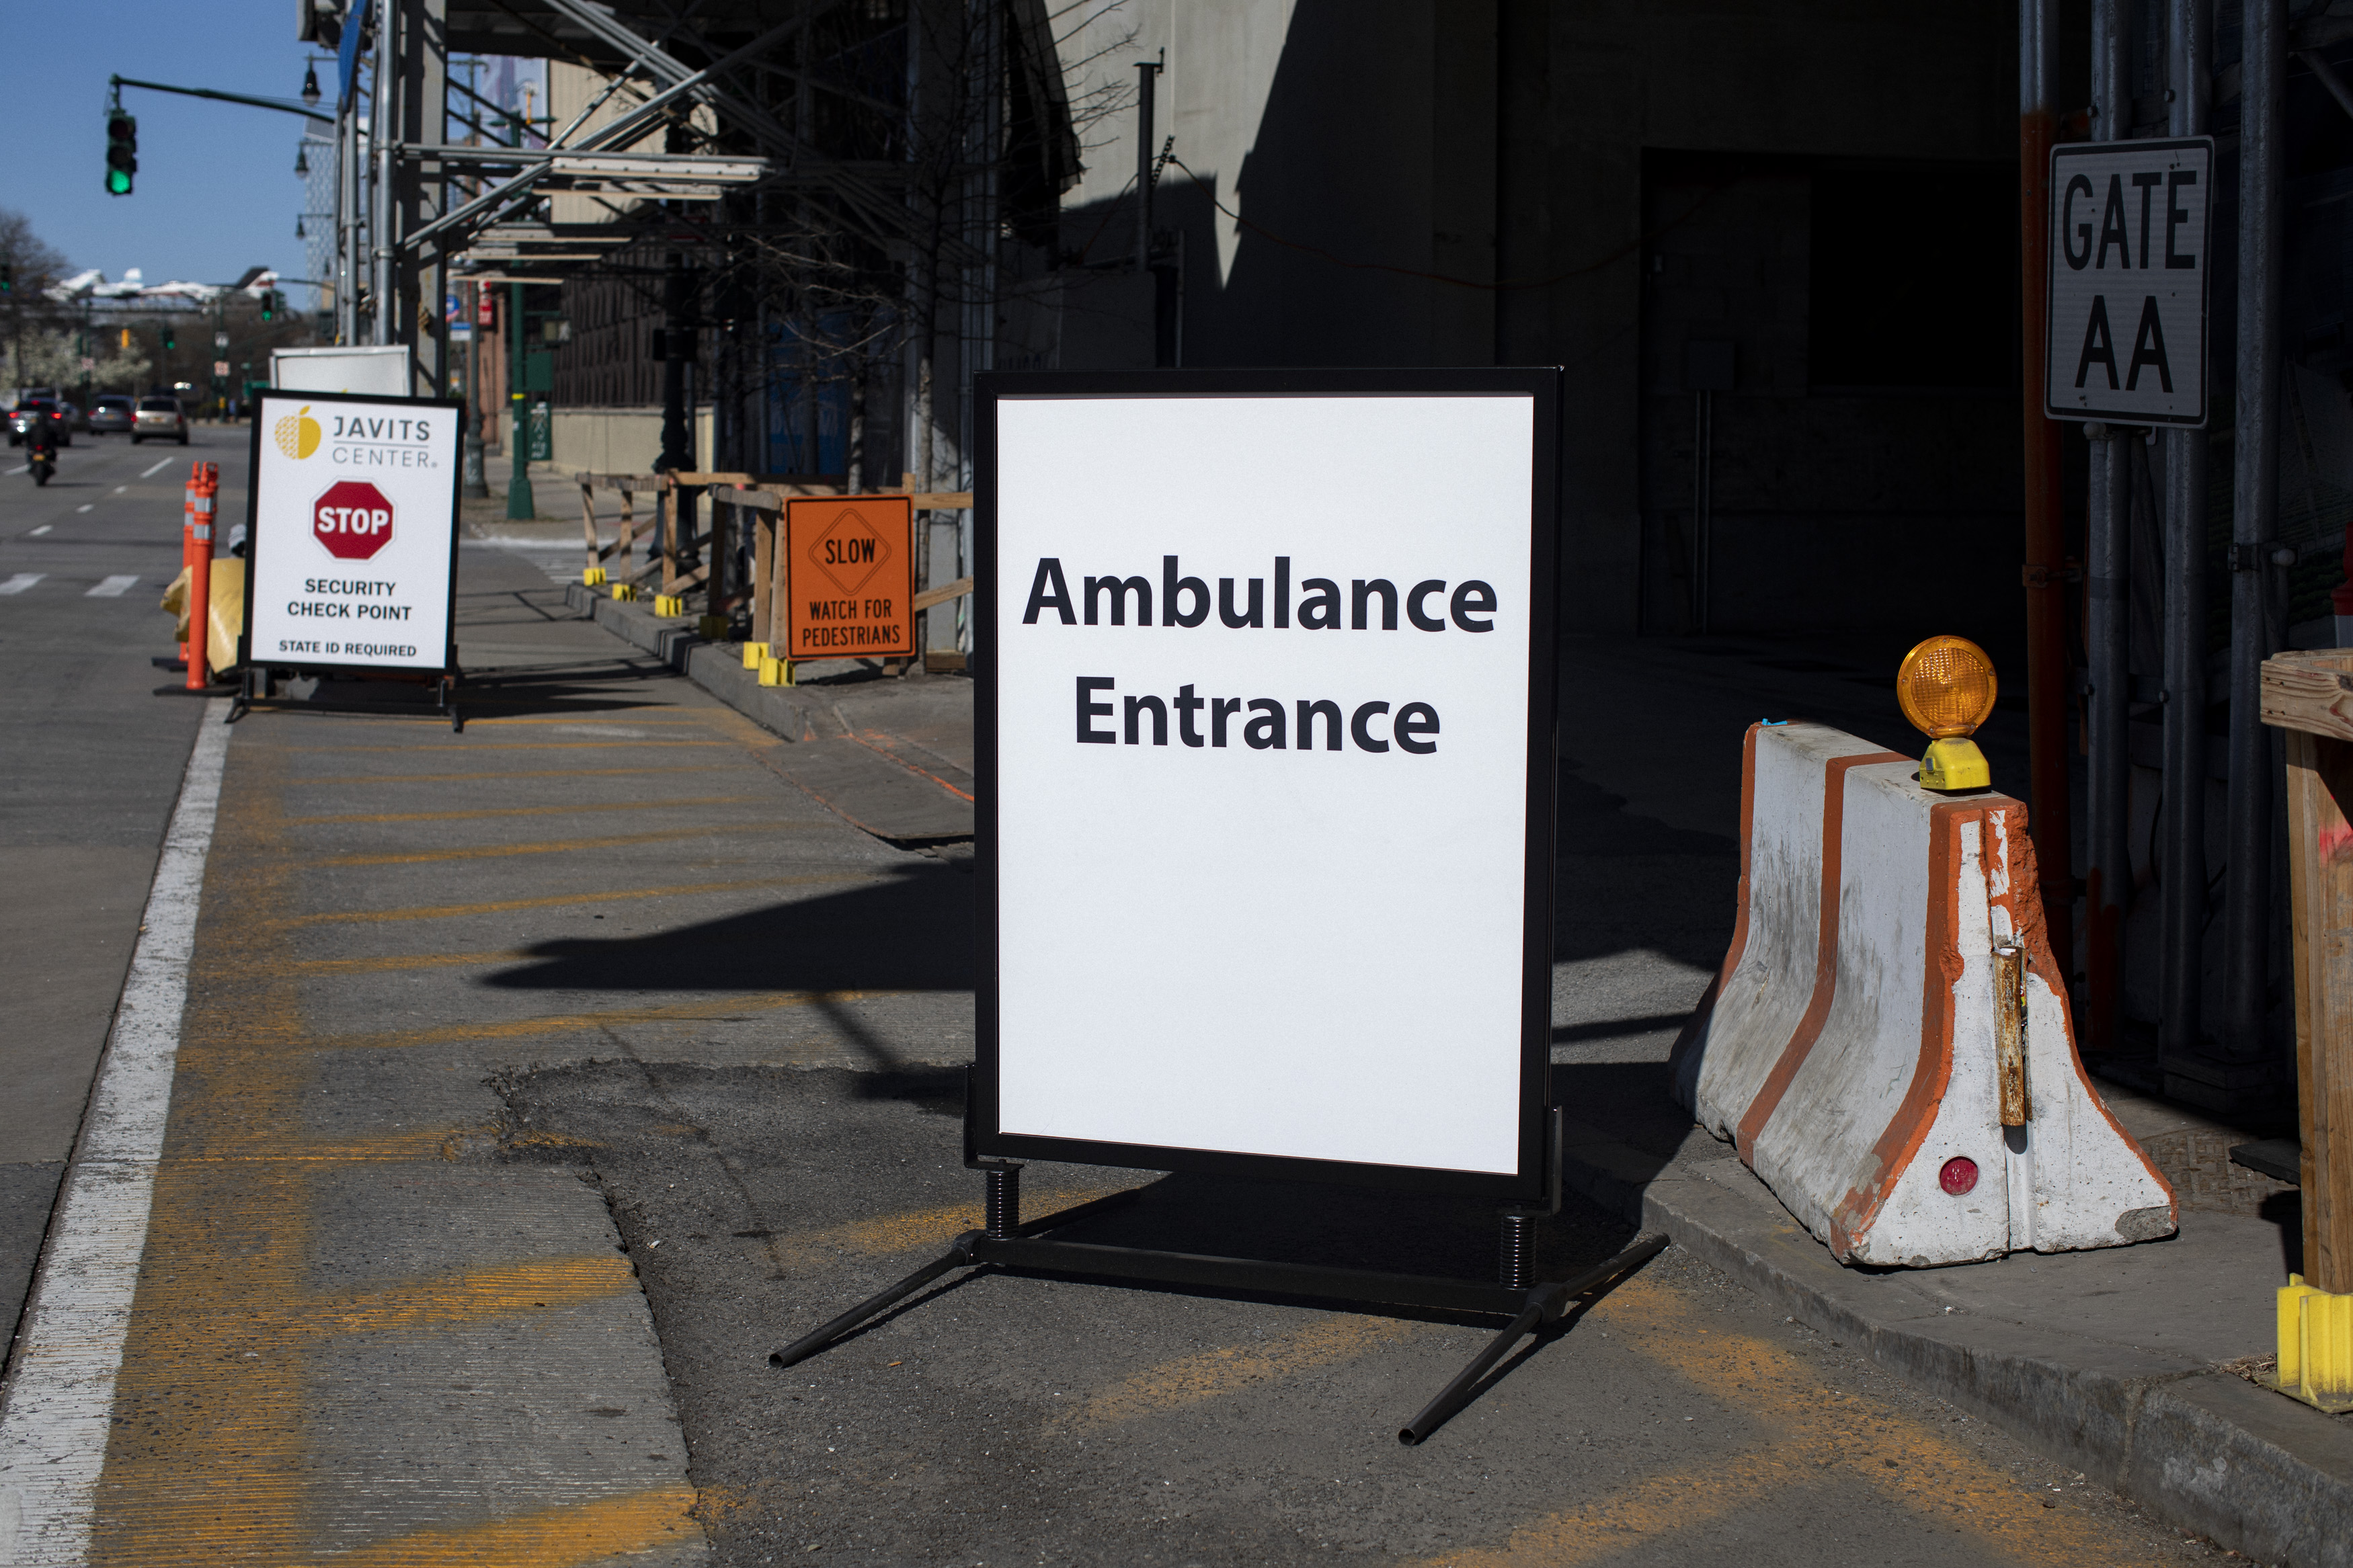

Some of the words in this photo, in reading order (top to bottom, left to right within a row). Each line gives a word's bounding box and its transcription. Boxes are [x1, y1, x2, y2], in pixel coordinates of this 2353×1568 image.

[2063, 170, 2198, 272] GATE
[2075, 294, 2175, 395] AA
[333, 416, 430, 441] JAVITS
[317, 506, 390, 536] STOP
[825, 538, 876, 565] SLOW
[305, 578, 396, 597] SECURITY
[1022, 554, 1498, 633] Ambulance
[287, 601, 350, 618] CHECK
[357, 604, 412, 621] POINT
[809, 600, 858, 621] WATCH
[864, 598, 893, 620] FOR
[279, 639, 321, 653] STATE
[325, 642, 340, 654] ID
[344, 643, 417, 657] REQUIRED
[802, 624, 901, 648] PEDESTRIANS
[1076, 675, 1441, 755] Entrance
